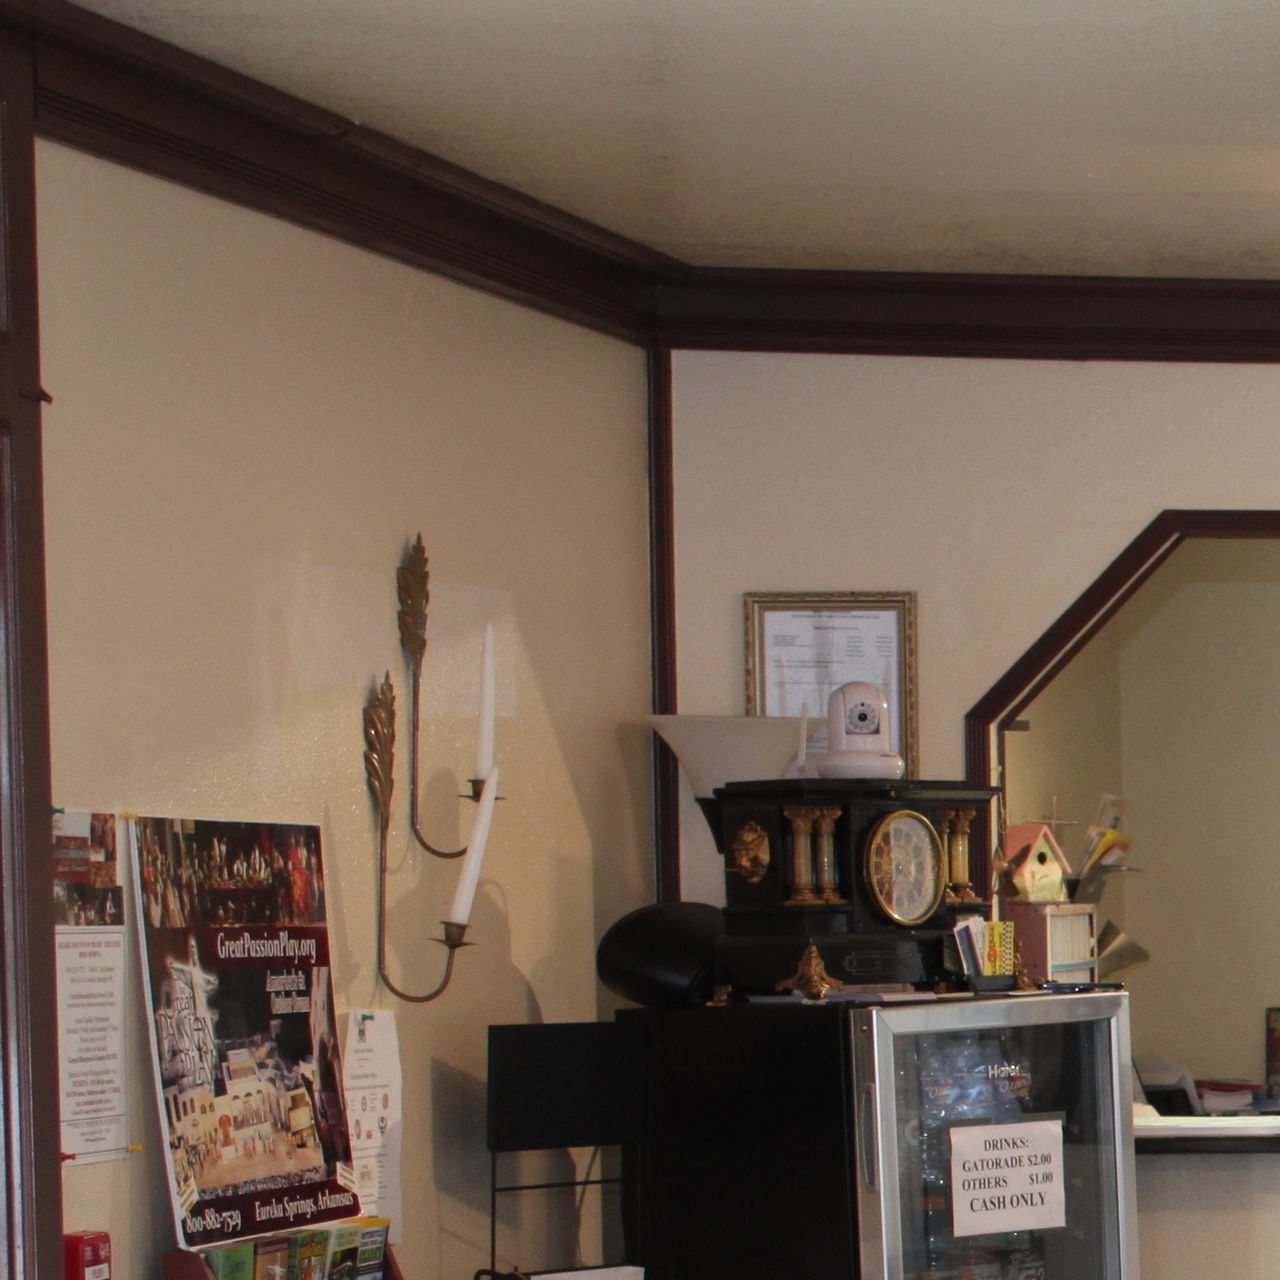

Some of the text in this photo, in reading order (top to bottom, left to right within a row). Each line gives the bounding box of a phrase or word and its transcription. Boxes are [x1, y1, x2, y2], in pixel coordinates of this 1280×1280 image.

[217, 931, 317, 964] GreatPassionPlay.org
[984, 1137, 1029, 1152] DRINKS:
[962, 1153, 1052, 1173] GATORADE $2.00
[962, 1172, 1054, 1192] OTHERS $1.00
[185, 1190, 354, 1234] 800-882-7529 Eureka Springs, Arkansas
[970, 1191, 1048, 1213] CASH ONLY
